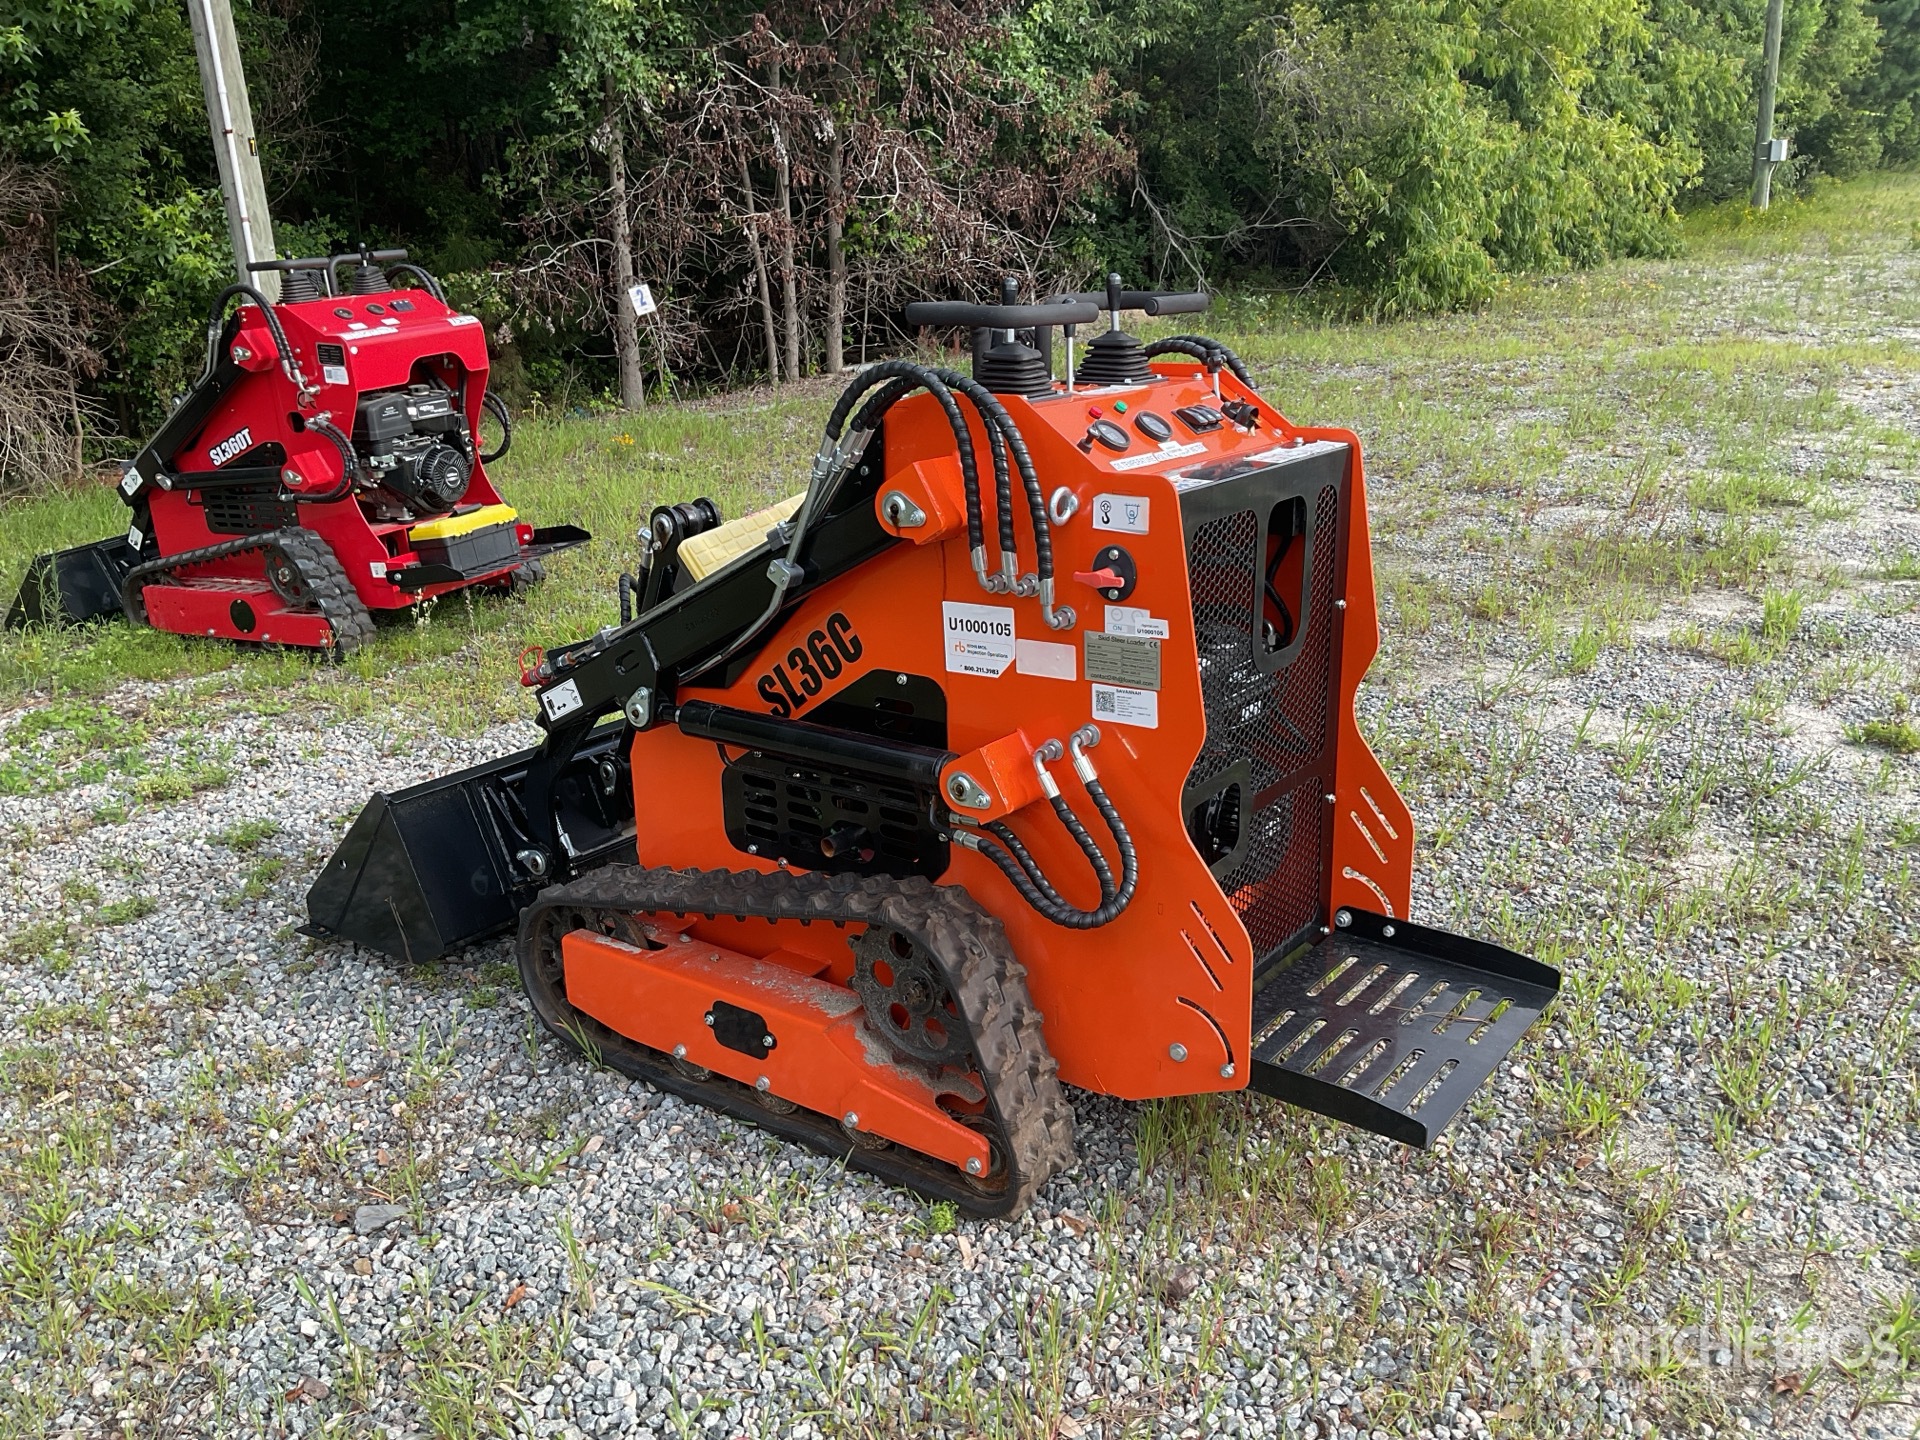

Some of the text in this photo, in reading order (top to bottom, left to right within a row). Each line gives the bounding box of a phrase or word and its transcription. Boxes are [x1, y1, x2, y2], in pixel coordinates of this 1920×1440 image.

[636, 288, 648, 307] 2
[208, 427, 254, 467] SL360T
[948, 616, 1012, 637] U1000105
[1136, 628, 1164, 637] U1000105
[954, 640, 966, 653] rb
[1098, 634, 1111, 643] Skid
[1111, 636, 1126, 645] Steer
[1126, 639, 1147, 647] Loader
[757, 611, 863, 719] SL36C
[1115, 688, 1143, 696] SAVANNAH
